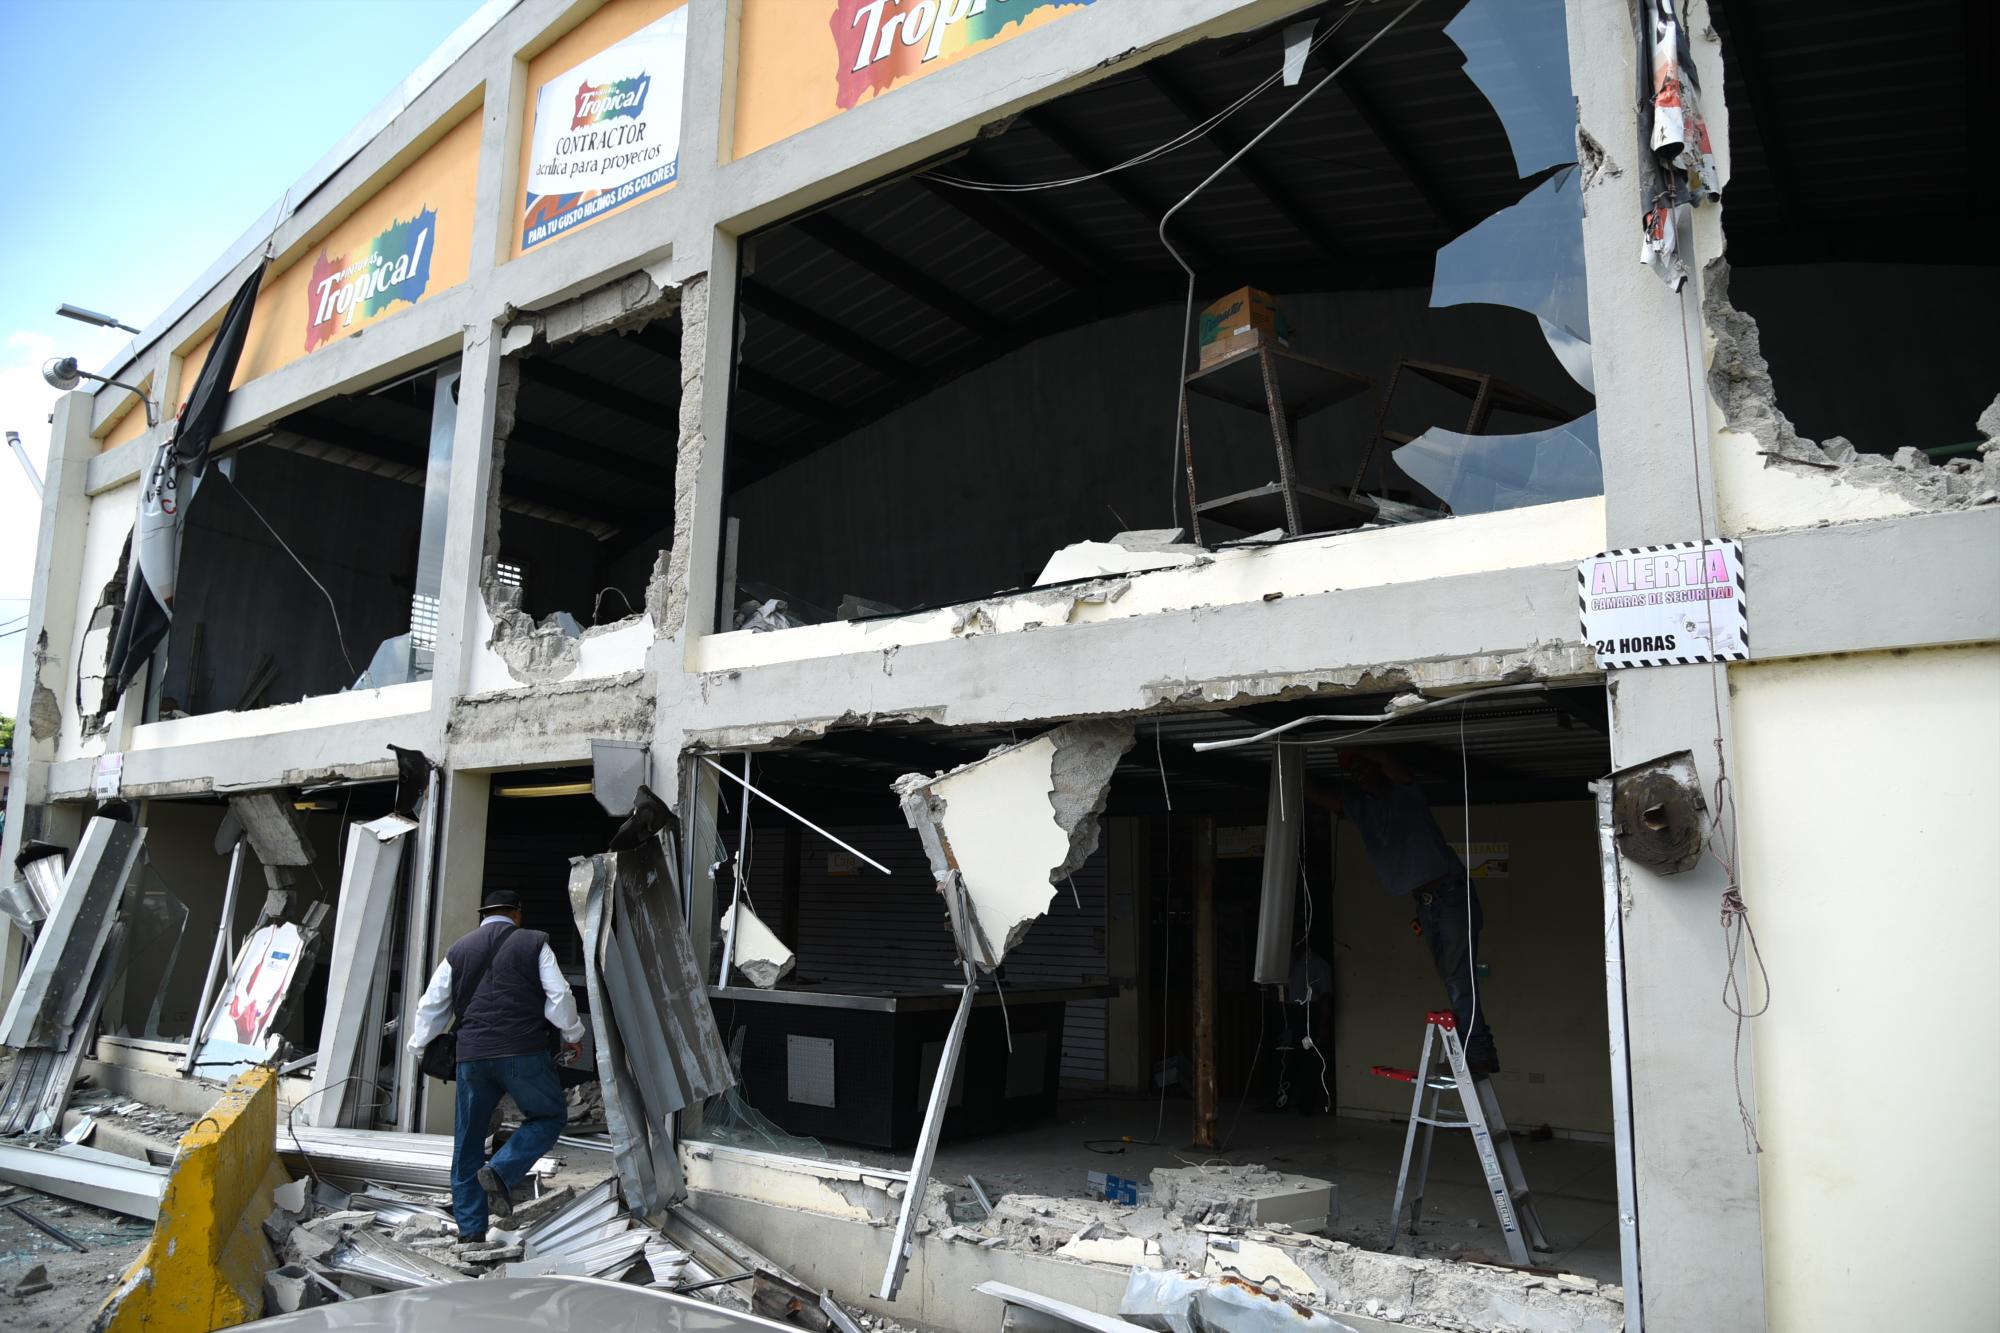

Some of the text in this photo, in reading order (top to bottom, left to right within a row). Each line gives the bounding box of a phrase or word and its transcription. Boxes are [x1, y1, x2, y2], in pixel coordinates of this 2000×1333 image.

[577, 81, 646, 121] Tropical
[556, 122, 646, 155] CONTRACTOR
[570, 159, 598, 178] para
[601, 144, 661, 175] proyectos
[527, 162, 675, 244] PARA TU GUSTO HICIMOS LOS COLORES
[313, 227, 428, 327] Tropical
[1591, 549, 1729, 595] ALERTA
[1591, 585, 1734, 611] CAMARAS DE SEGURIDAD
[1595, 634, 1676, 655] 24 HORAS
[1494, 1190, 1515, 1232] TOOLCRAFT
